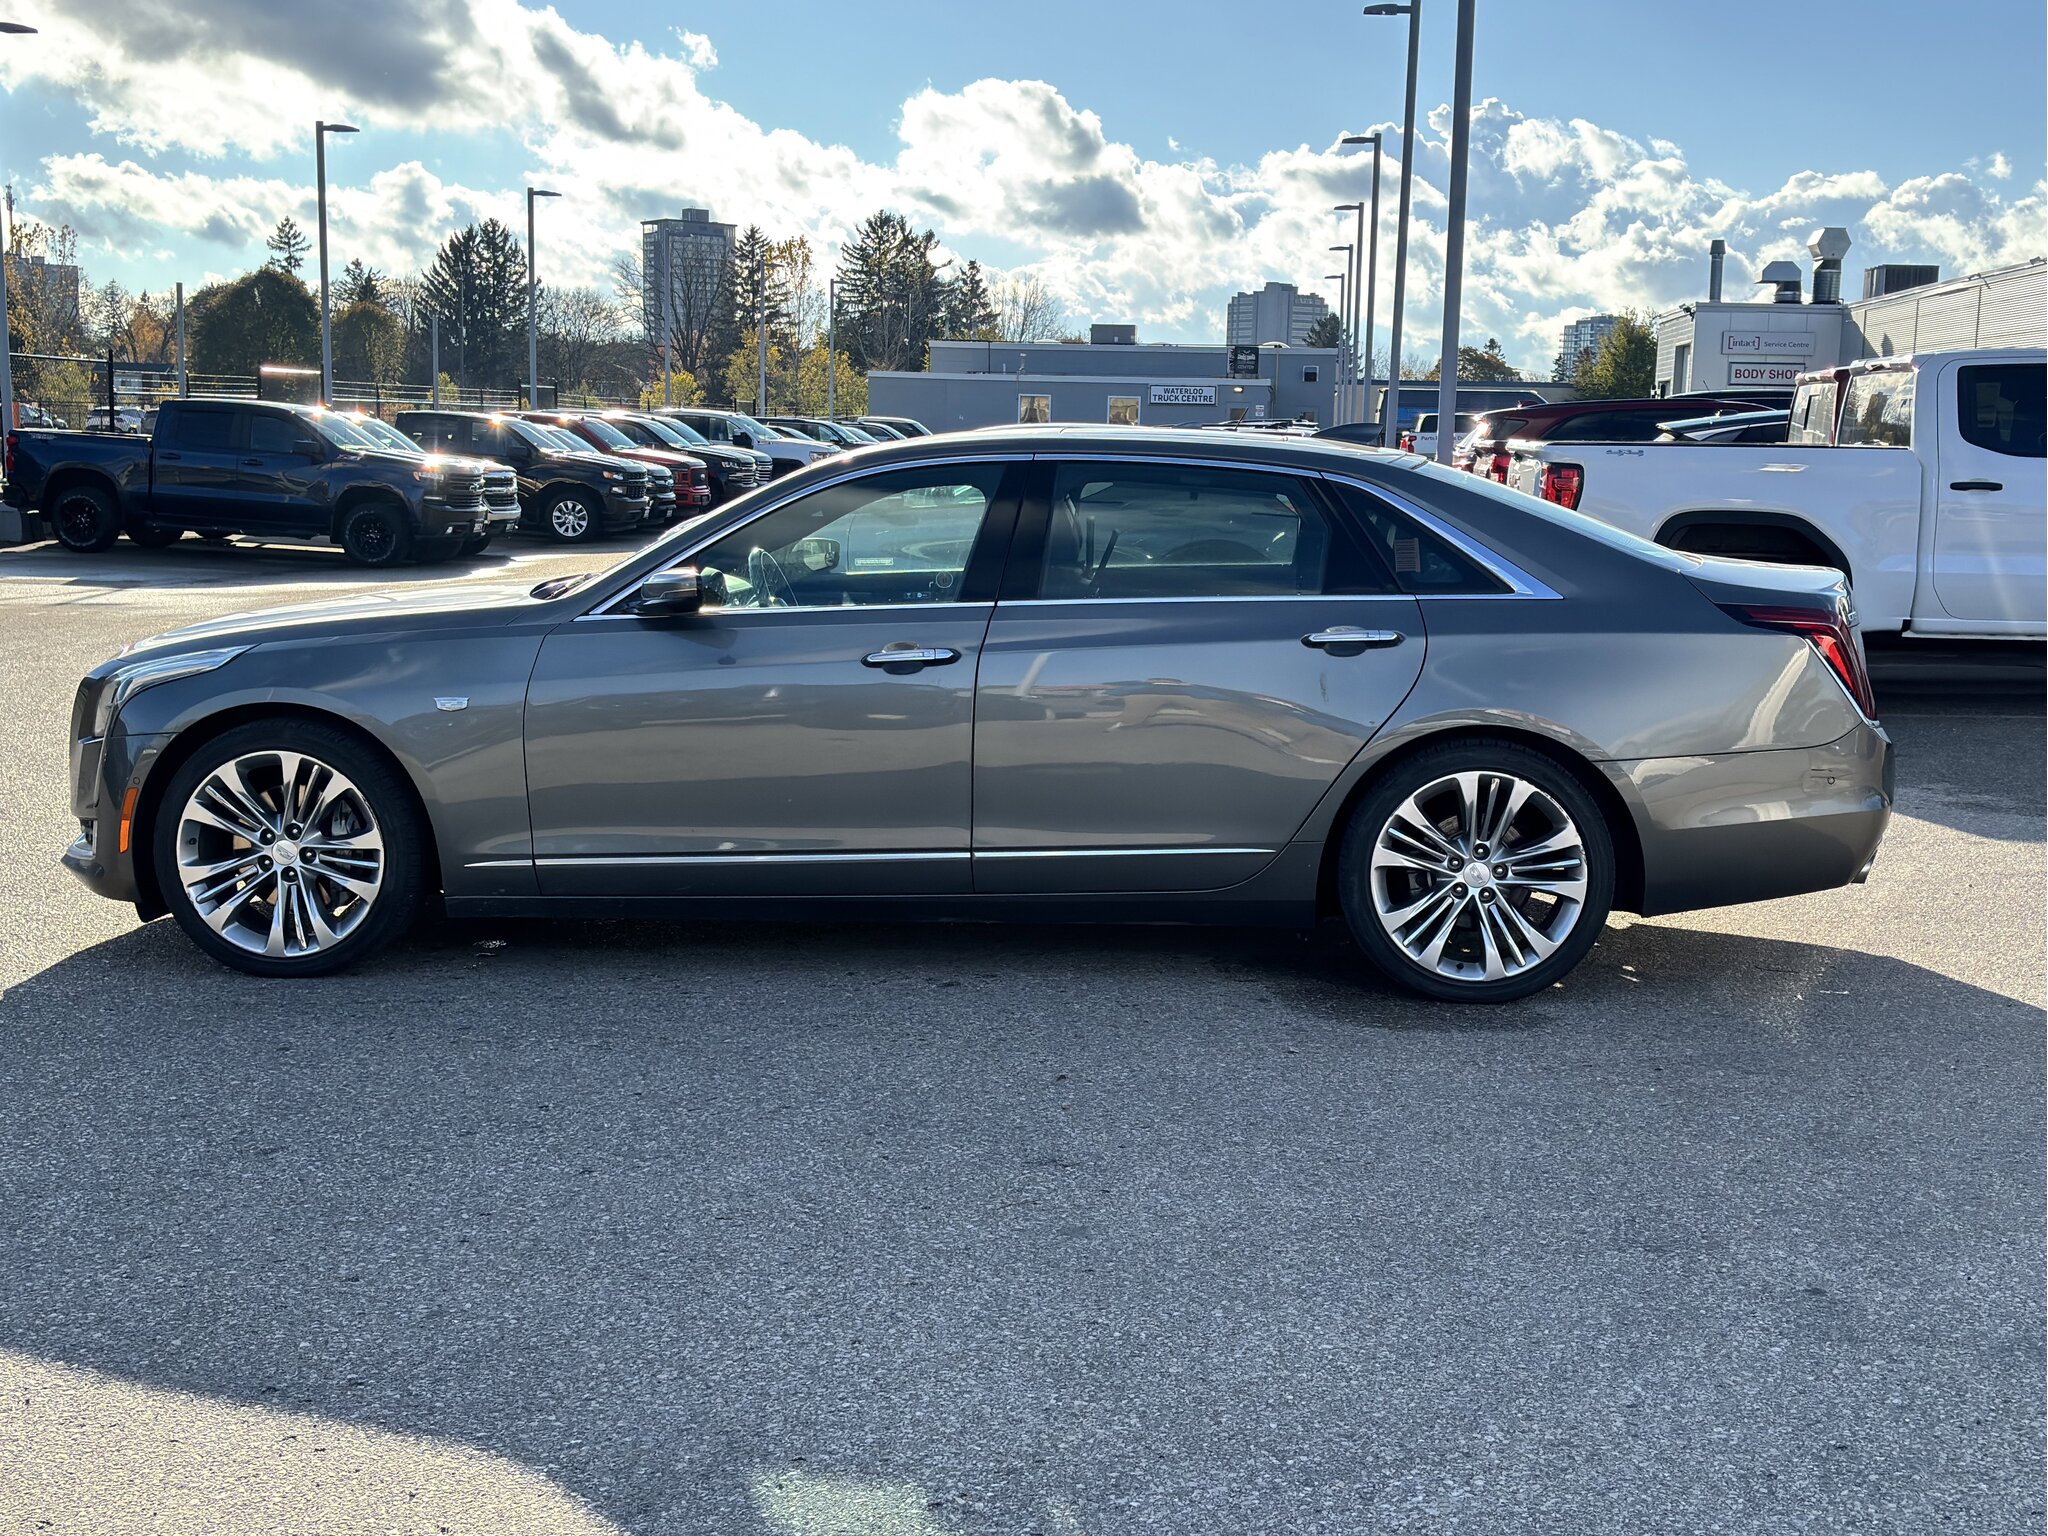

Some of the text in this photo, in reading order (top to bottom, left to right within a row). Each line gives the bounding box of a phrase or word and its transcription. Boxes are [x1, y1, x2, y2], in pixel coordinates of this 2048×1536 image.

[1735, 369, 1766, 379] BODY
[1153, 394, 1214, 403] TRUCK CENTRE
